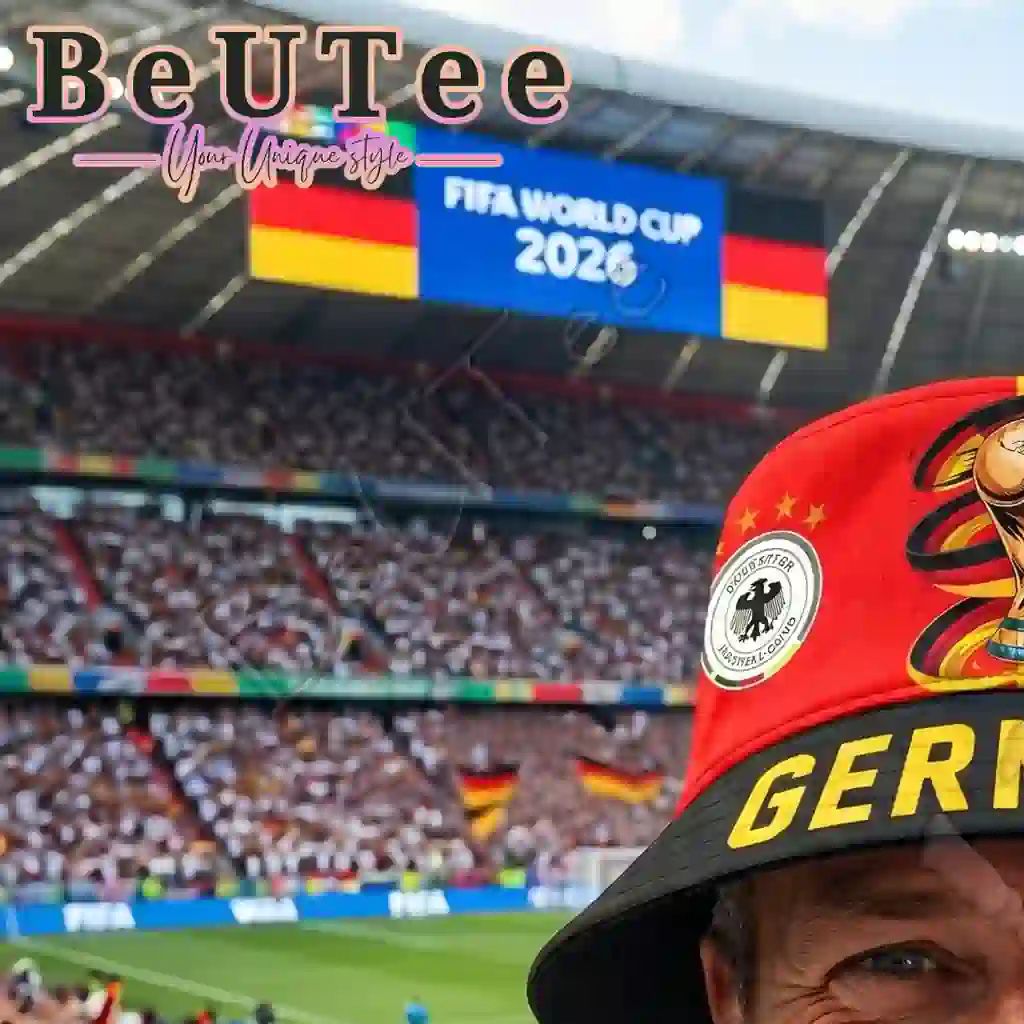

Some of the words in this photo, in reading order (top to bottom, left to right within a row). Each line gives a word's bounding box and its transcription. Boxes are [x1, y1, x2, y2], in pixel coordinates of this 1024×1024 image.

[443, 175, 519, 218] FIFA
[520, 187, 638, 236] WORLD
[639, 207, 703, 246] CUP
[514, 226, 638, 288] 2026
